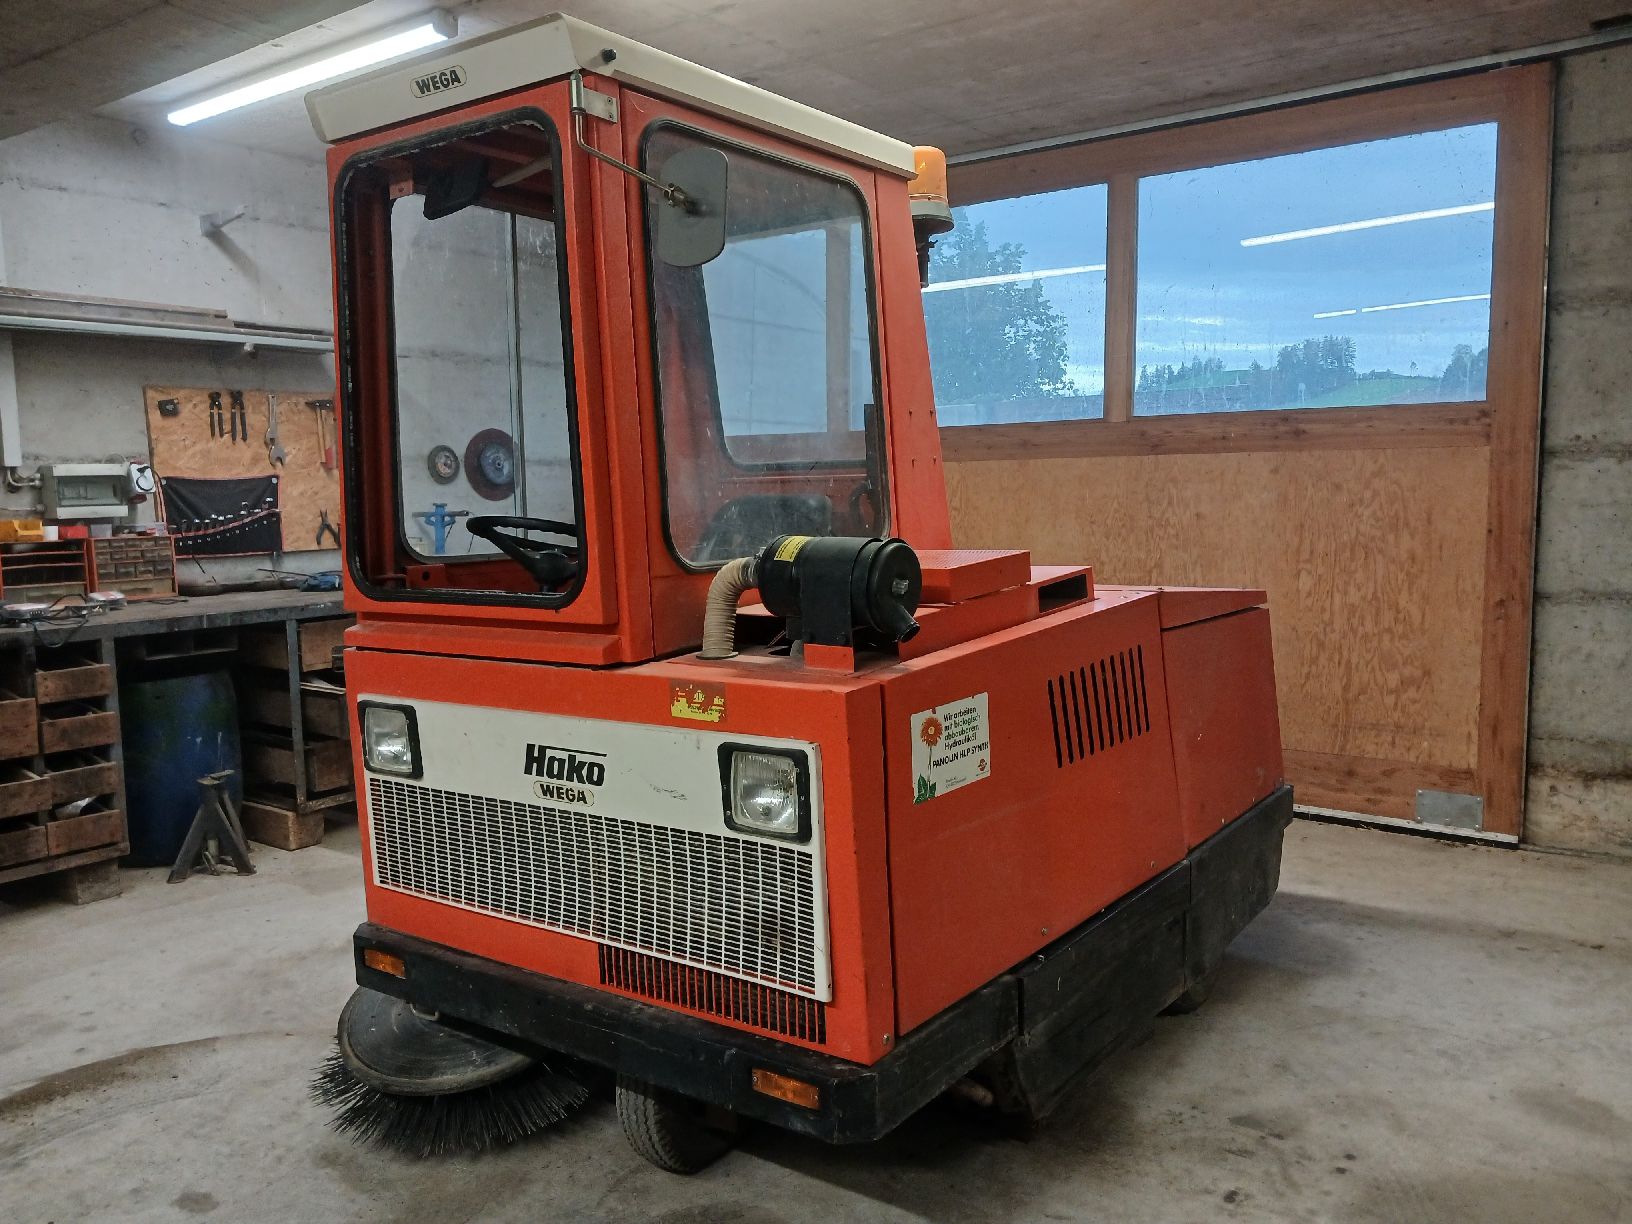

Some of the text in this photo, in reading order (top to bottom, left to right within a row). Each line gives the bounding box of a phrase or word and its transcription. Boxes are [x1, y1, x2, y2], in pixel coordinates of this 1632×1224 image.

[415, 70, 461, 94] WEGA
[944, 707, 977, 722] Wir arbeiten
[944, 713, 981, 732] mit biologisch
[524, 743, 607, 787] Hako
[932, 741, 989, 769] PANOLIN HLP SYNTH
[539, 783, 588, 804] WEGA
